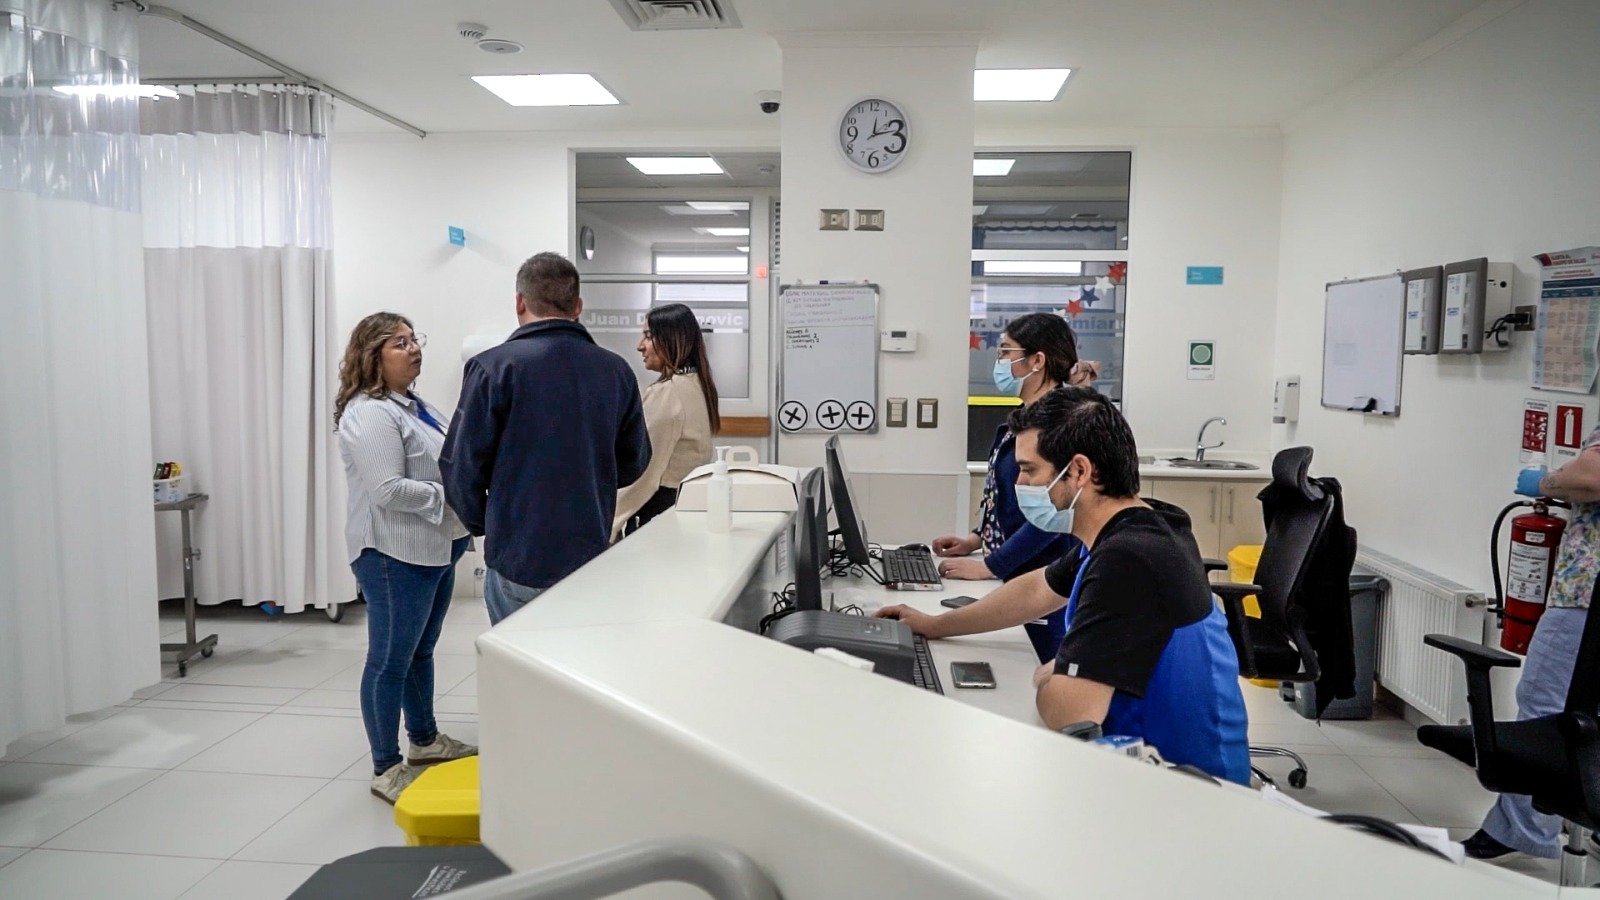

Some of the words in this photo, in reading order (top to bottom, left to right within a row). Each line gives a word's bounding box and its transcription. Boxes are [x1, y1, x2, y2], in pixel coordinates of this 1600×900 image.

[857, 106, 865, 114] 11
[870, 102, 880, 112] 12
[847, 117, 857, 125] 10
[847, 125, 859, 143] 9
[883, 119, 907, 154] 3
[846, 143, 854, 154] 8
[860, 151, 866, 159] 7
[867, 150, 880, 168] 6
[883, 153, 889, 161] 5
[585, 312, 630, 326] Juan
